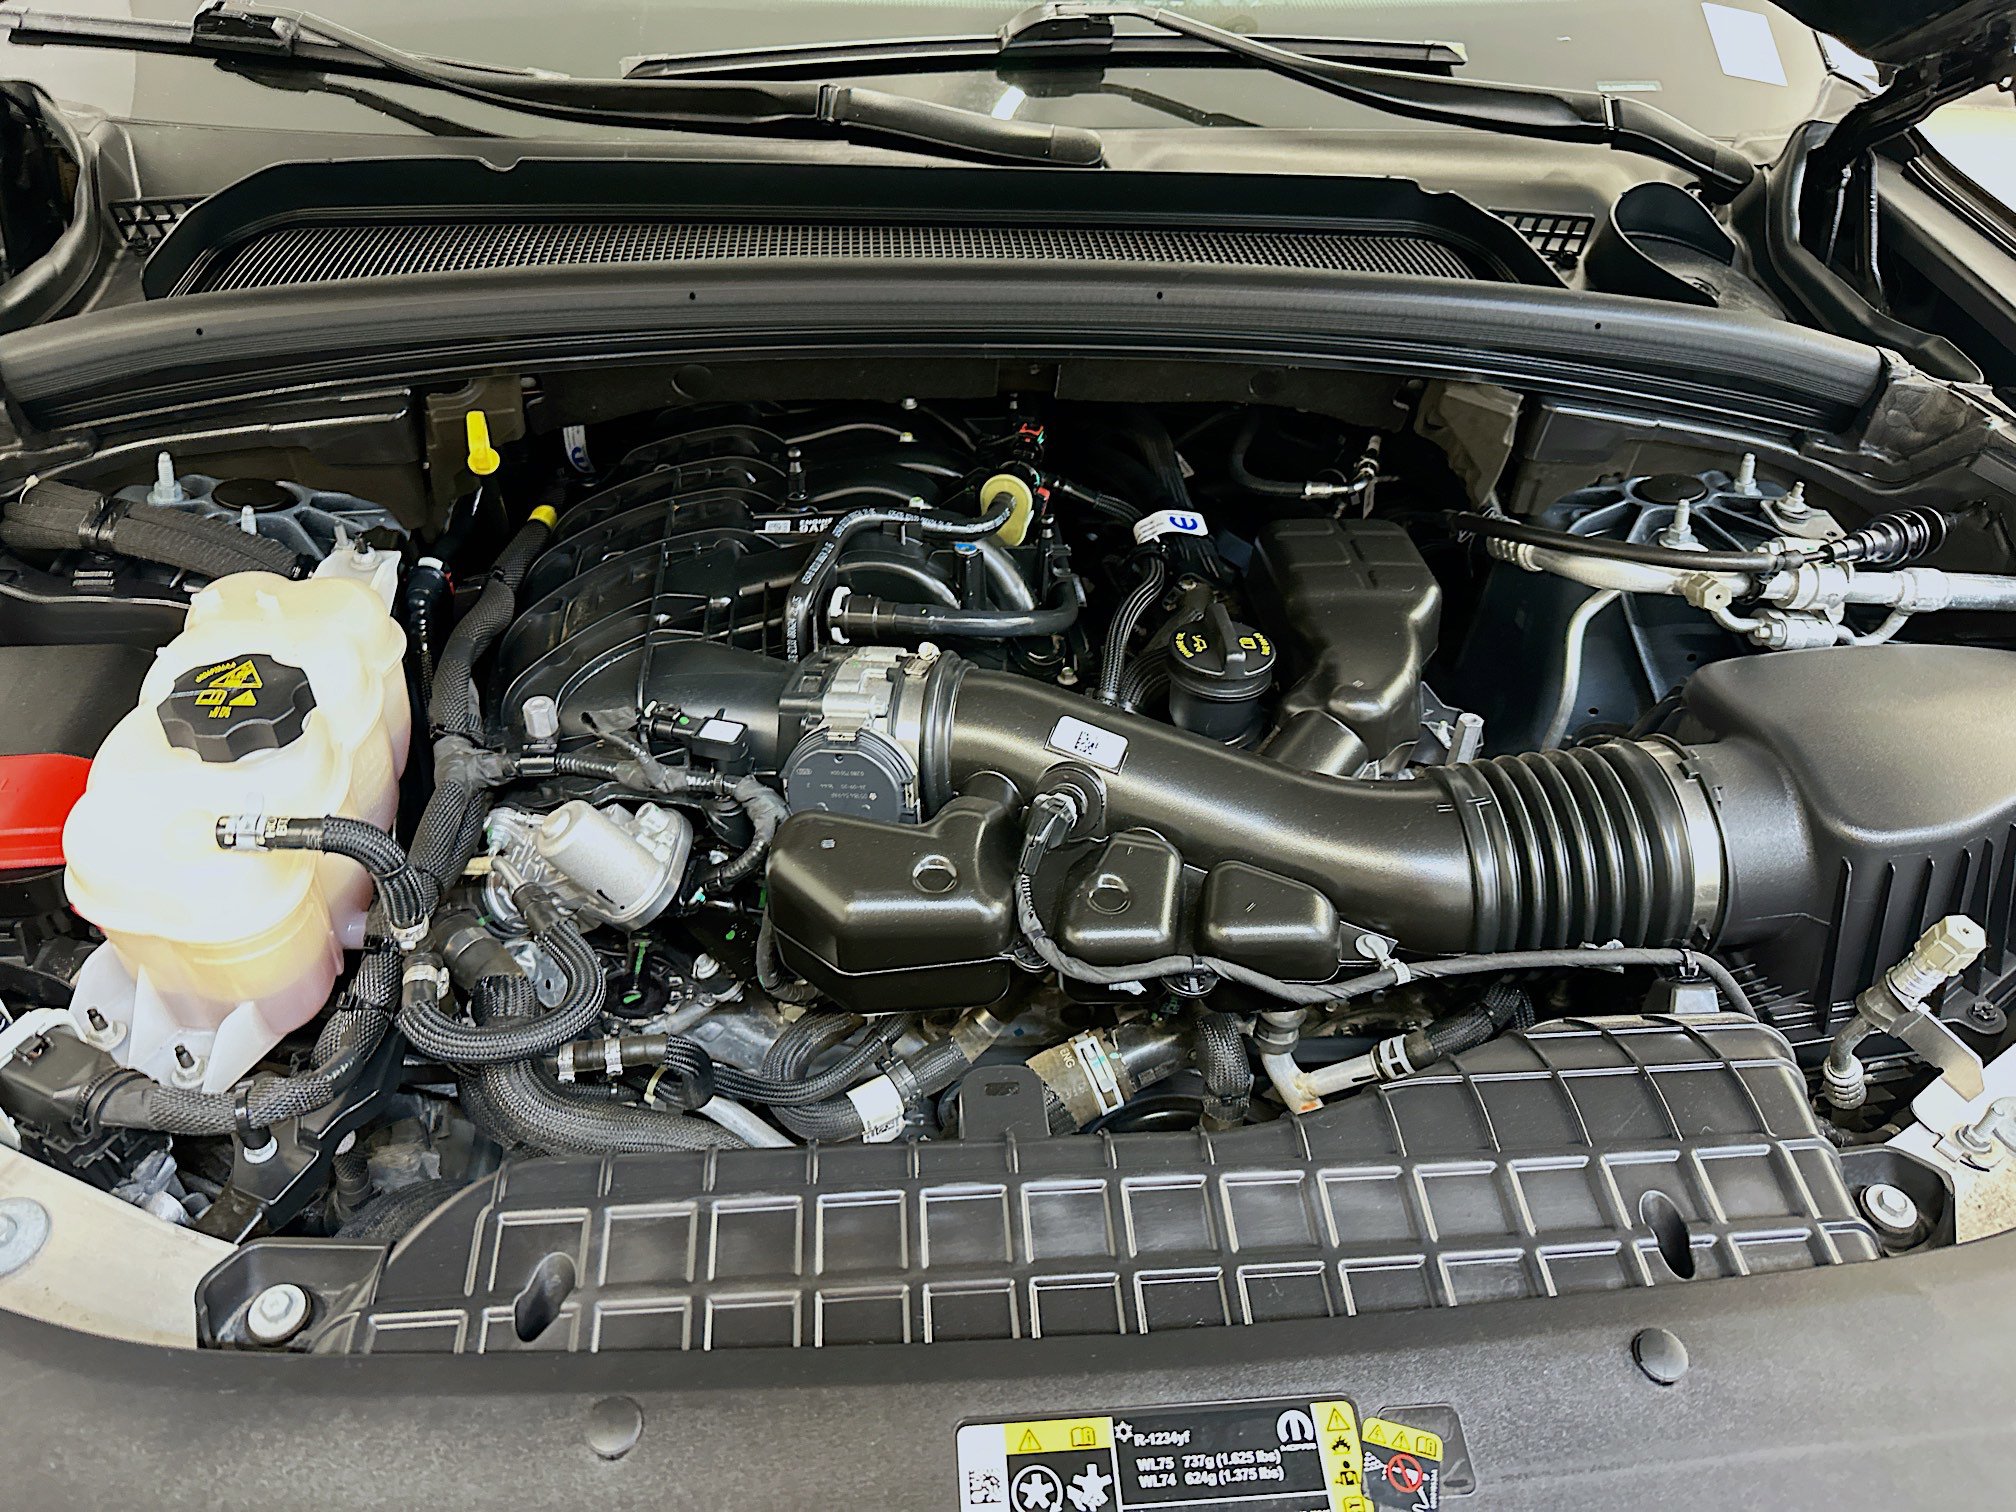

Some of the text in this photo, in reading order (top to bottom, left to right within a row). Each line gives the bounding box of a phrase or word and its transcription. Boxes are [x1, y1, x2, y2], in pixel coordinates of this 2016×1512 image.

[1059, 1047, 1076, 1069] ENG
[1133, 1429, 1191, 1447] R-1234yf
[1135, 1456, 1175, 1472] WL75
[1181, 1454, 1215, 1470] 737g
[1255, 1448, 1282, 1465] lbs)
[1137, 1465, 1285, 1489] WL74 624g (1.375 lbs)
